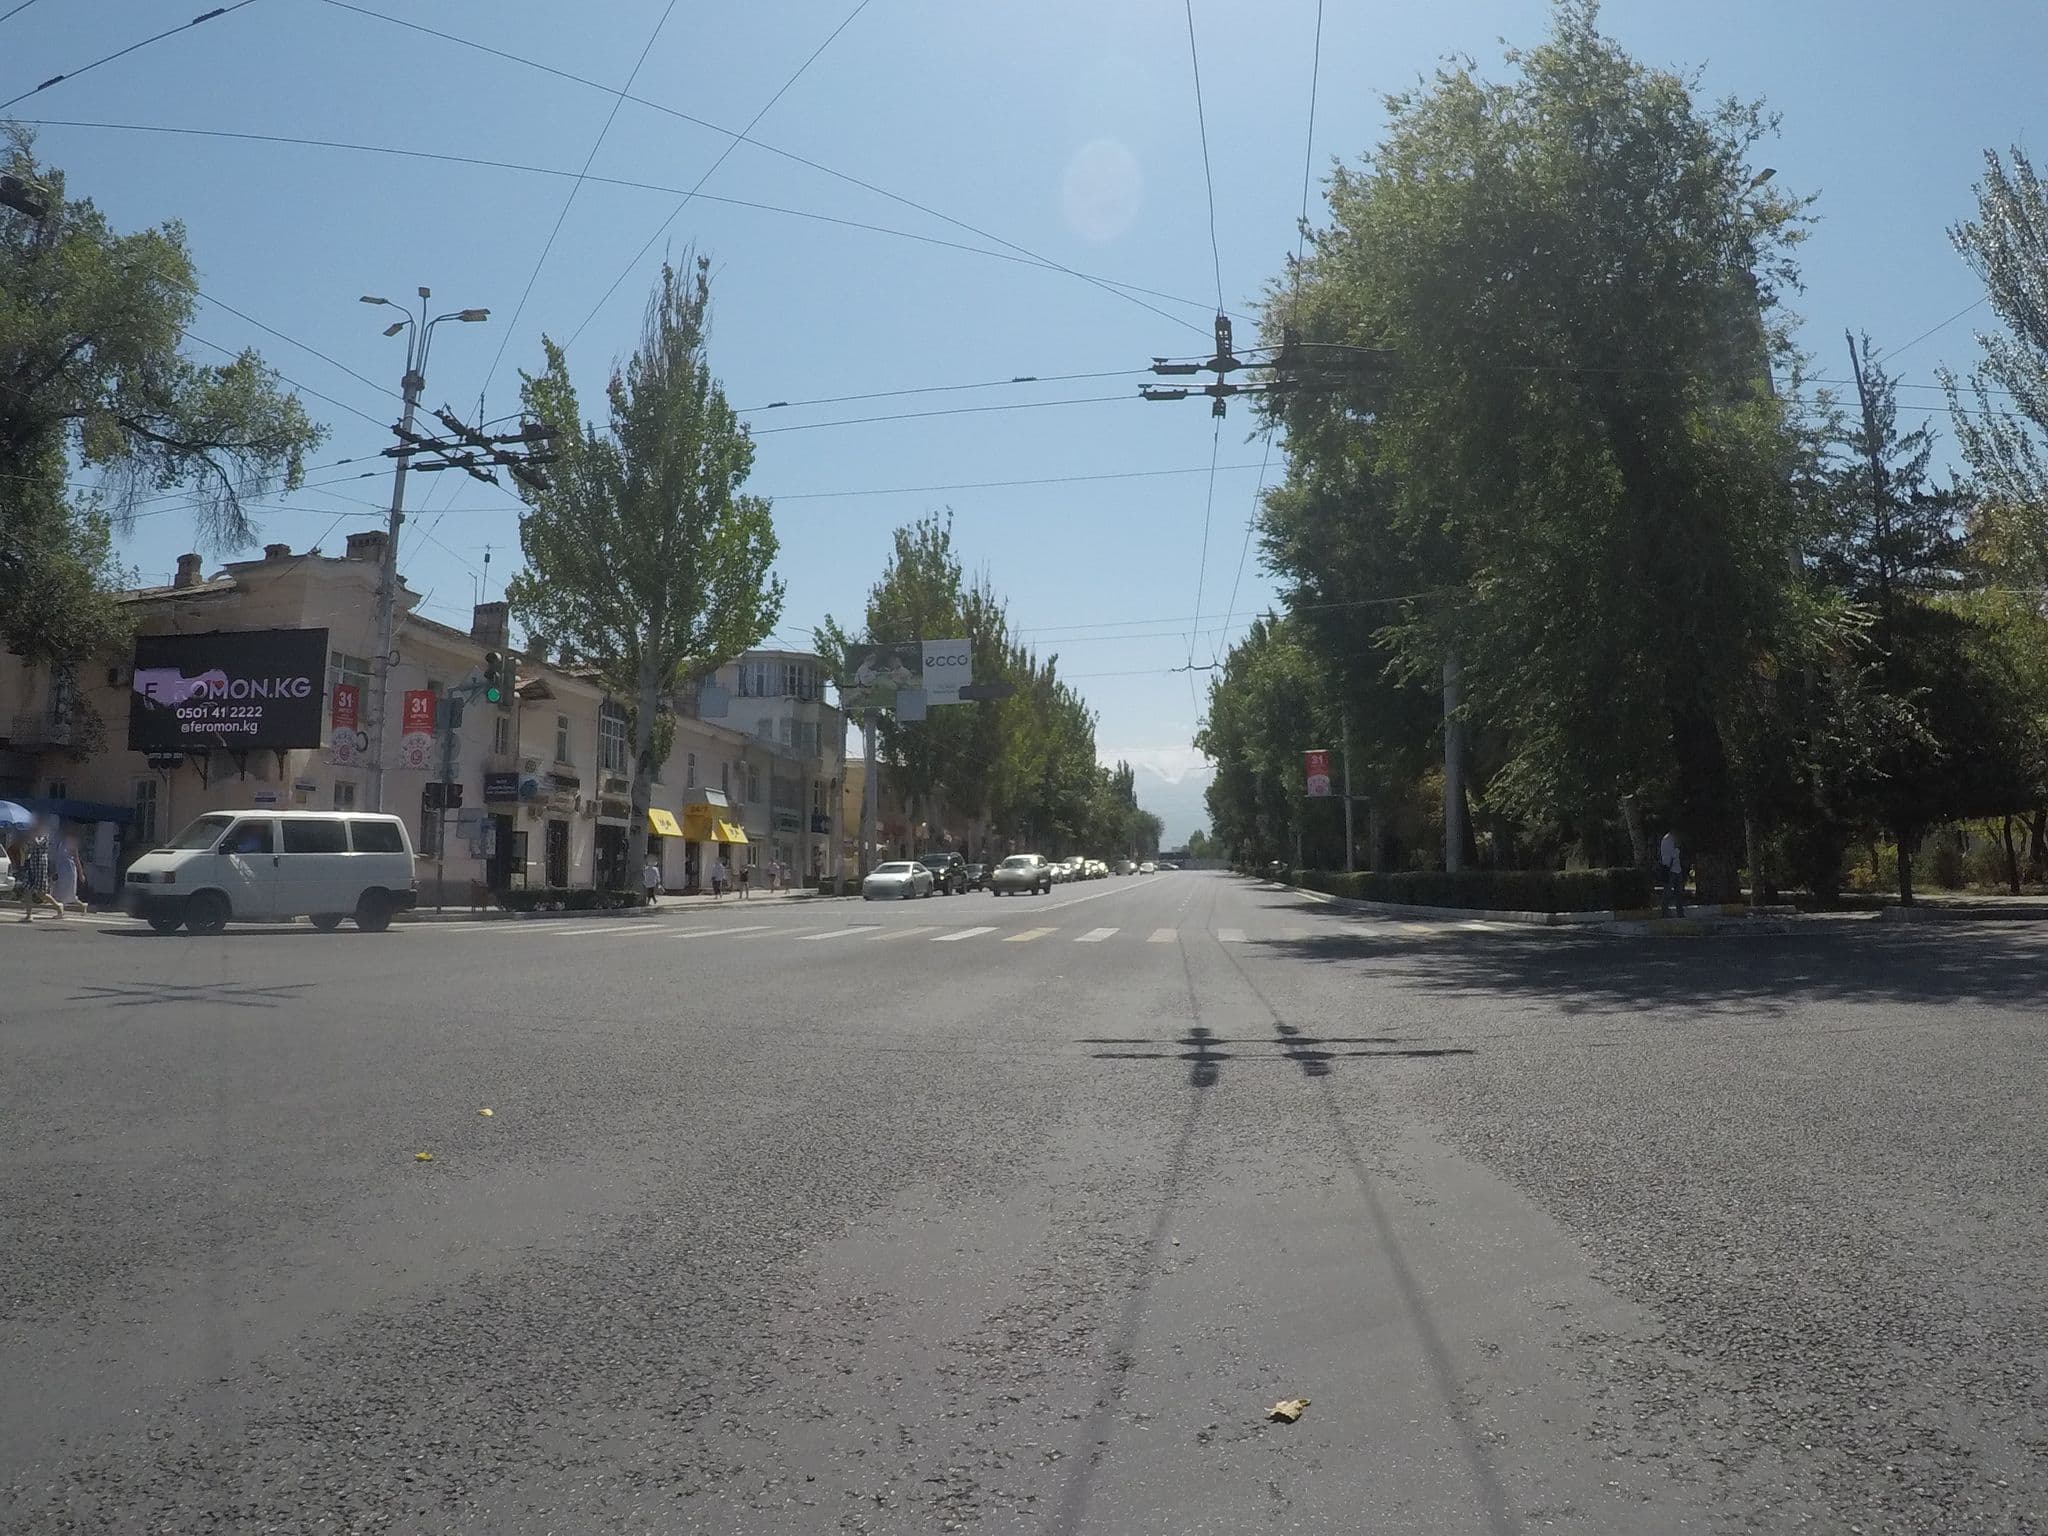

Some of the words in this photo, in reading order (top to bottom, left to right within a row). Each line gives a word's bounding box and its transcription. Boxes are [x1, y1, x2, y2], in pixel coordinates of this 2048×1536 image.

[925, 653, 967, 667] ecco
[338, 691, 352, 708] 31
[411, 697, 428, 713] 31
[176, 707, 208, 719] 0501
[211, 707, 226, 718] 41
[229, 706, 263, 718] 2222
